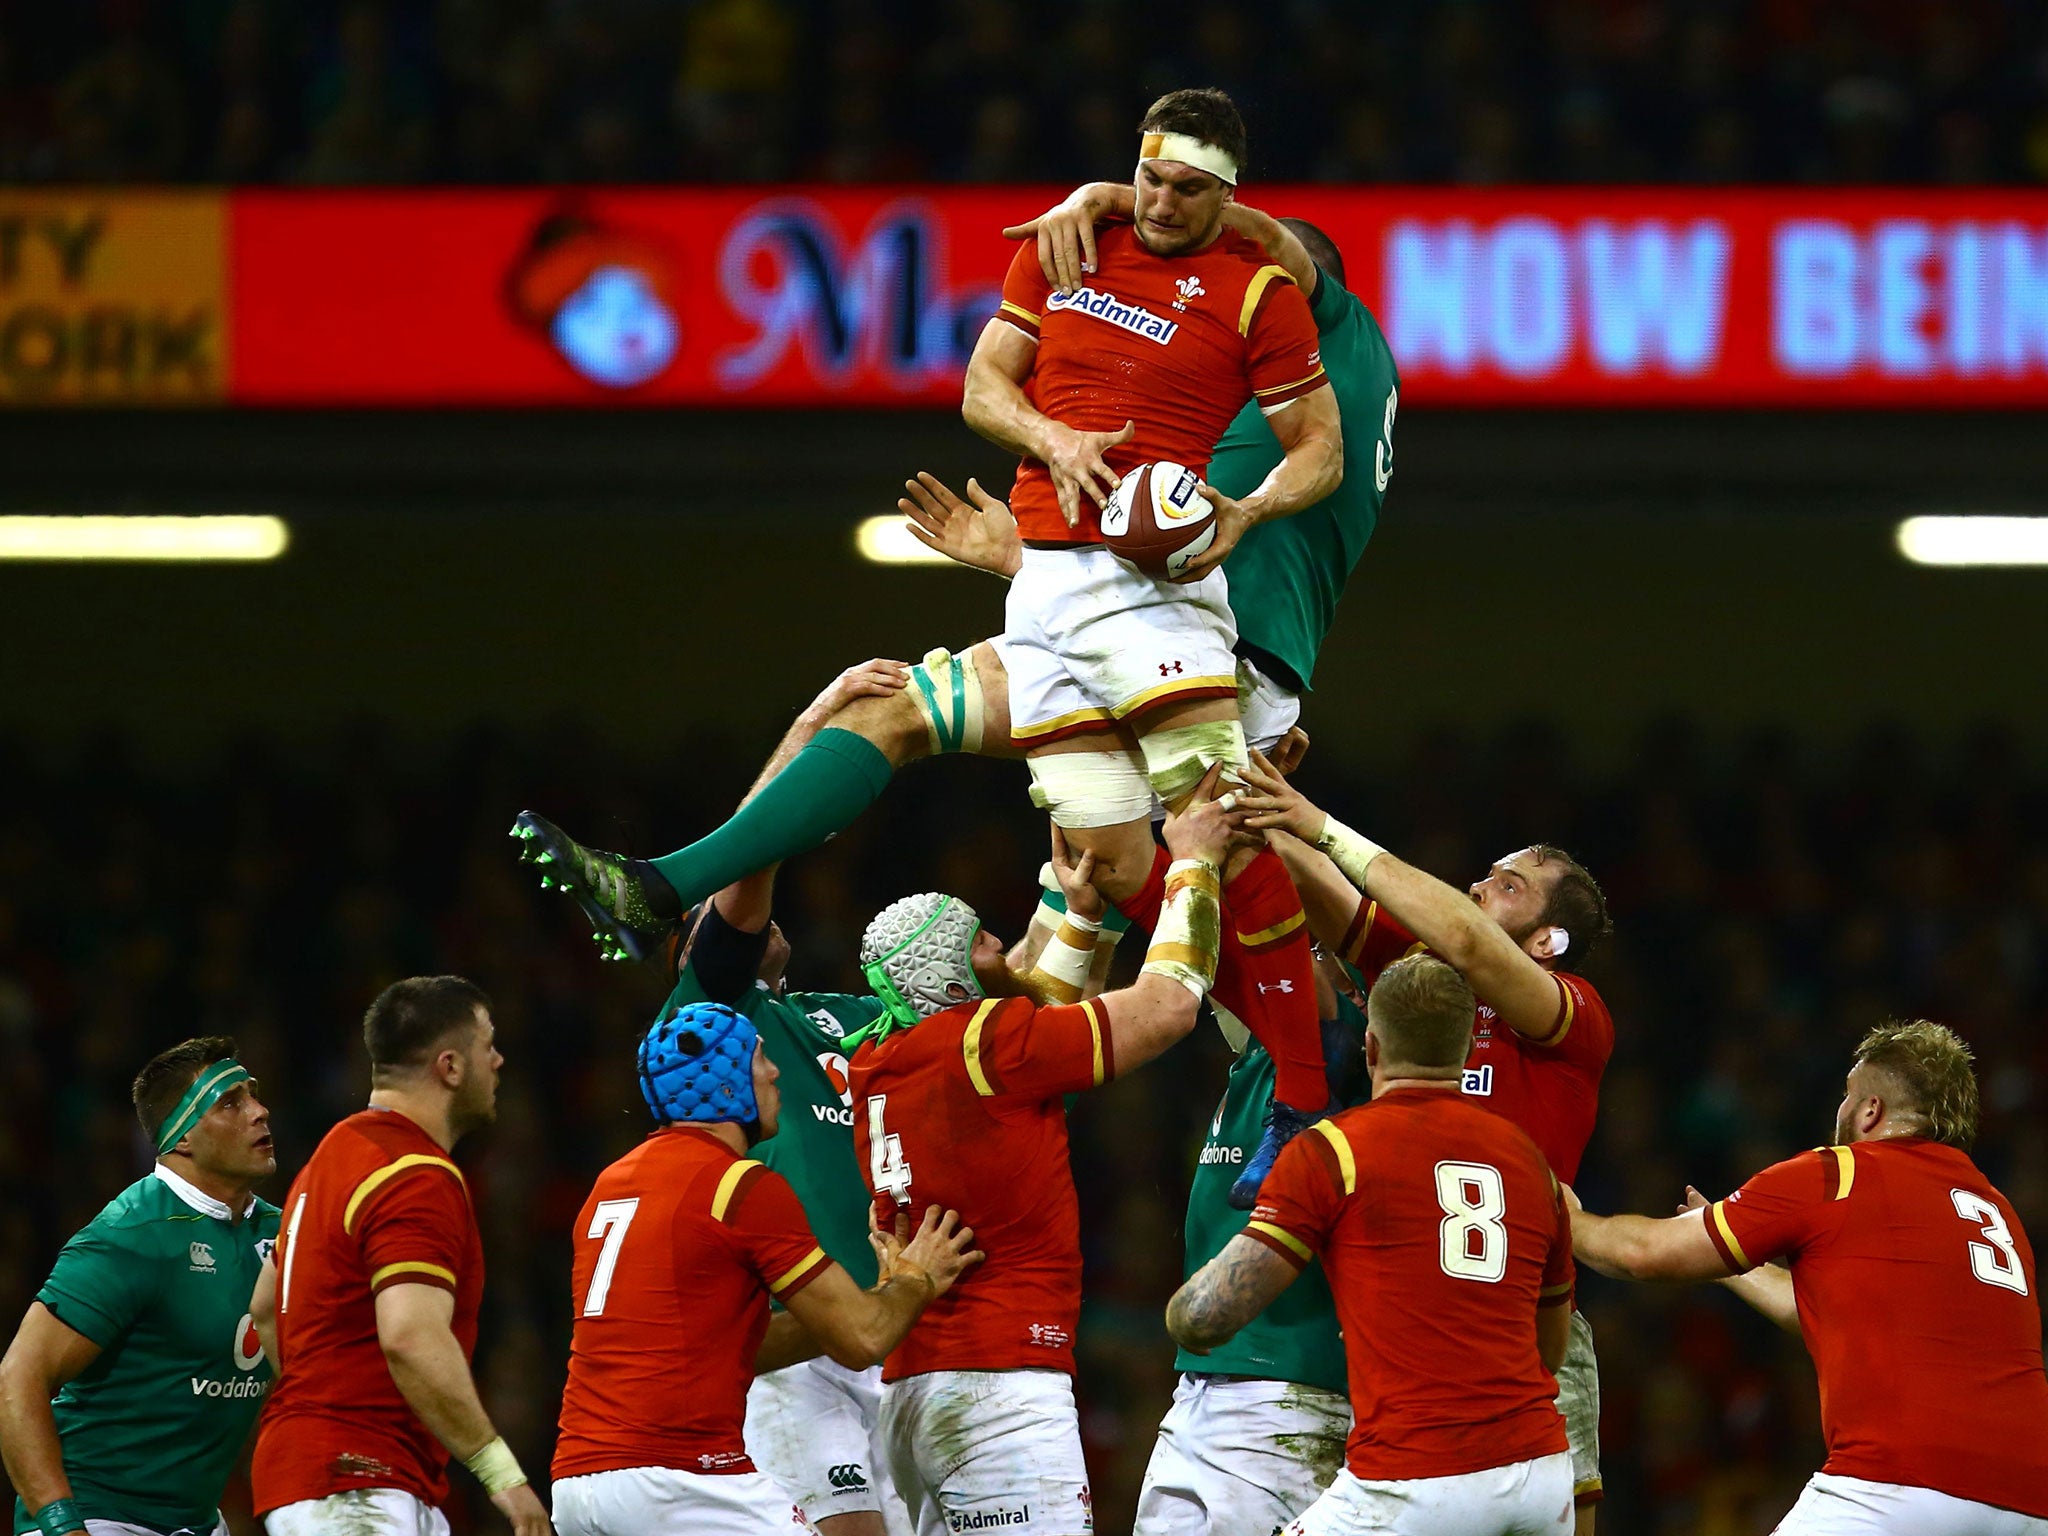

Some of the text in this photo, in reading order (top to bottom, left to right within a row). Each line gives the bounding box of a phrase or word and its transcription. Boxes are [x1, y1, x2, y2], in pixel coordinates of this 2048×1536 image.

[1072, 290, 1178, 342] Admiral
[1386, 219, 1730, 378] NOW
[867, 1093, 912, 1207] 4
[583, 1197, 640, 1317] 7
[1433, 1160, 1508, 1284] 8
[1949, 1187, 2029, 1297] 3
[962, 1505, 1030, 1531] Admiral
